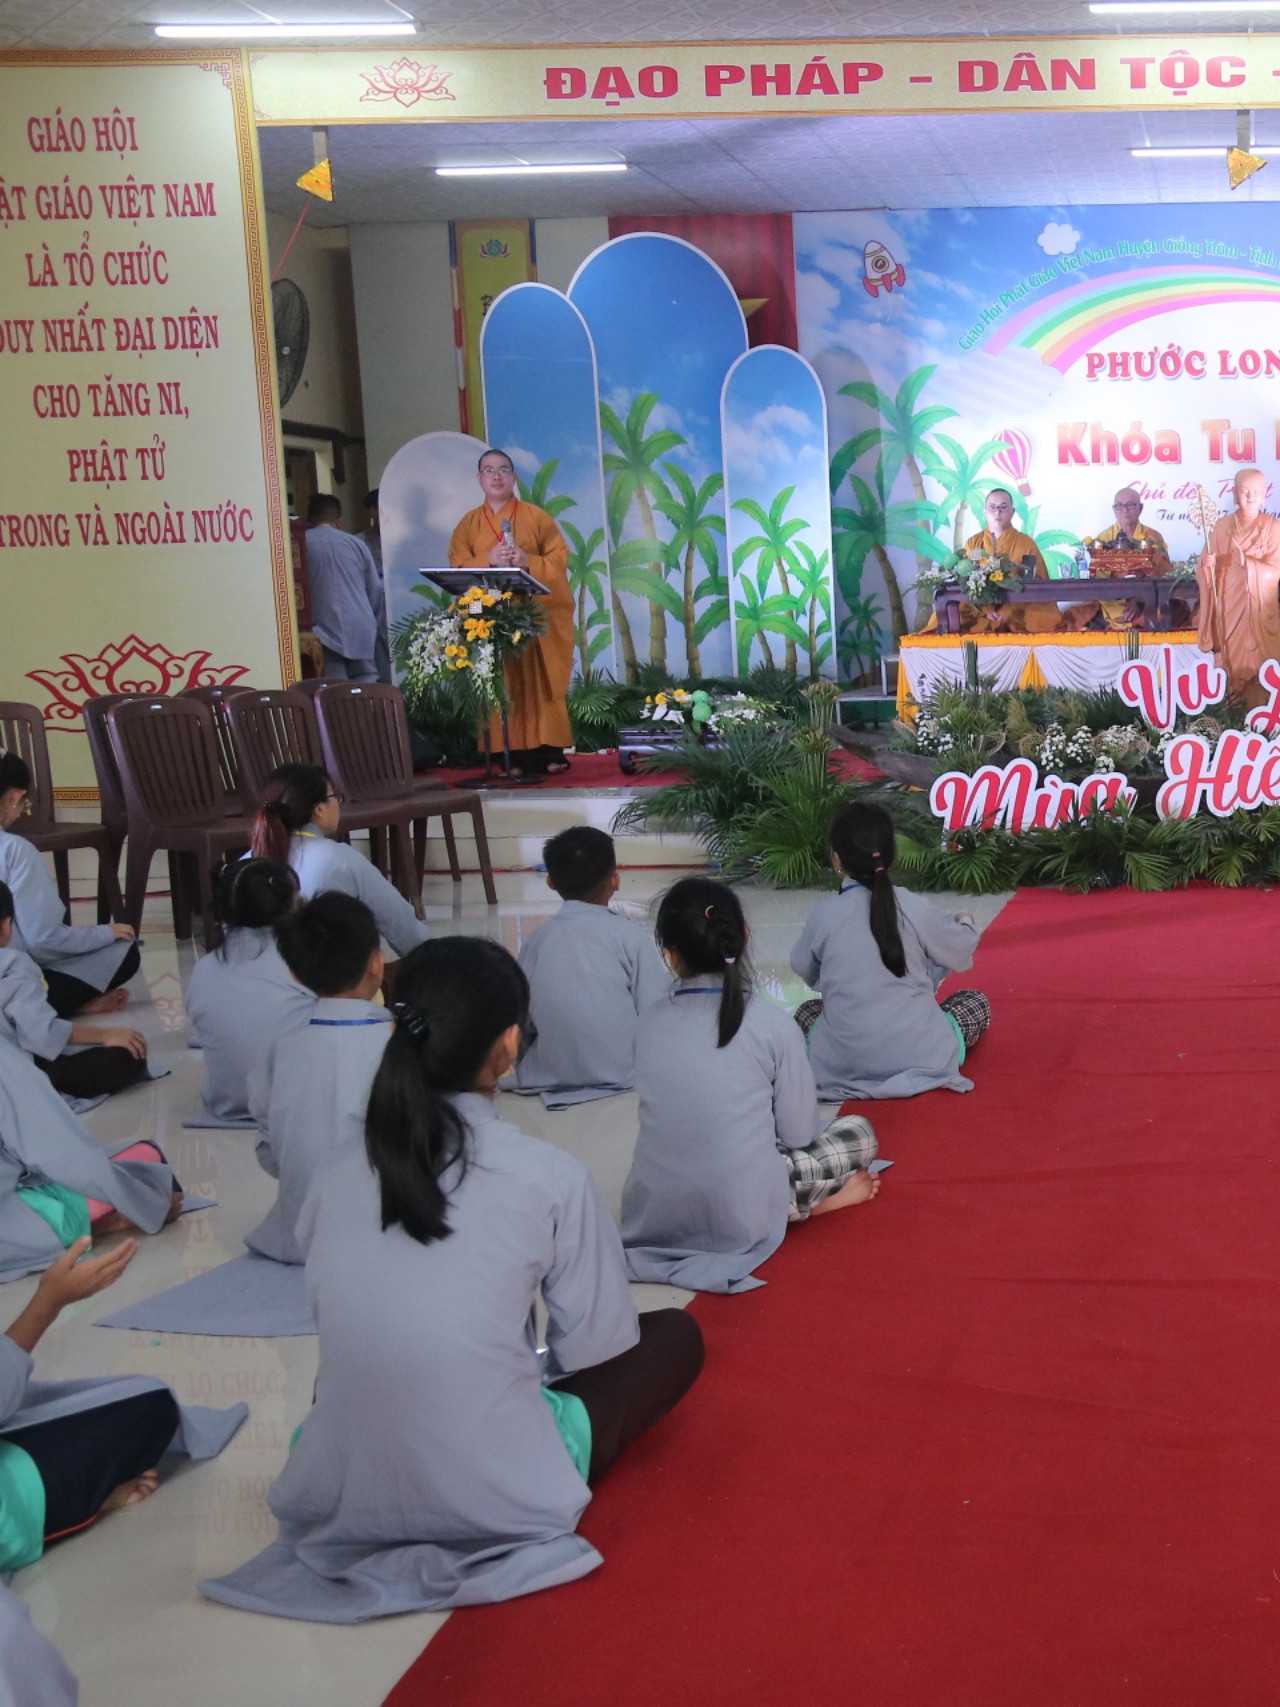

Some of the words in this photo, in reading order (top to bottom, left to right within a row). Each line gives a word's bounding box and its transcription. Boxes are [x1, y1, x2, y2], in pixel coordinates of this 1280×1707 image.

[543, 66, 679, 106] ĐẠO
[705, 56, 883, 96] PHÁP
[958, 53, 1096, 92] DÂN
[1120, 50, 1246, 96] TỘC
[28, 106, 86, 152] GIÁO
[92, 106, 138, 160] HỘI
[35, 175, 93, 220] GIÁO
[98, 174, 155, 227] VIỆT
[163, 182, 217, 217] NAM
[25, 242, 58, 287] LÀ
[64, 230, 94, 287] TỔ
[103, 240, 169, 285] CHỨC
[1083, 246, 1116, 264] Nam
[1117, 239, 1161, 258] Huyện
[0, 319, 34, 353] UY
[42, 301, 106, 353] NHẤT
[113, 316, 157, 359] ĐẠI
[162, 306, 219, 358] DIỆN
[1085, 343, 1206, 379] PHƯỚC
[33, 384, 80, 418] CHO
[87, 374, 150, 416] TĂNG
[157, 382, 189, 419] NI,
[67, 439, 128, 490] PHẬT
[135, 433, 165, 481] TỬ
[1056, 420, 1182, 466] Khóa
[1200, 419, 1257, 463] Tu
[1217, 478, 1274, 499] Pt
[75, 503, 109, 546] VÀ
[114, 501, 186, 545] NGOÀI
[192, 499, 254, 543] NƯỚC
[1122, 648, 1222, 728] Vu
[935, 763, 1133, 836] Mùa
